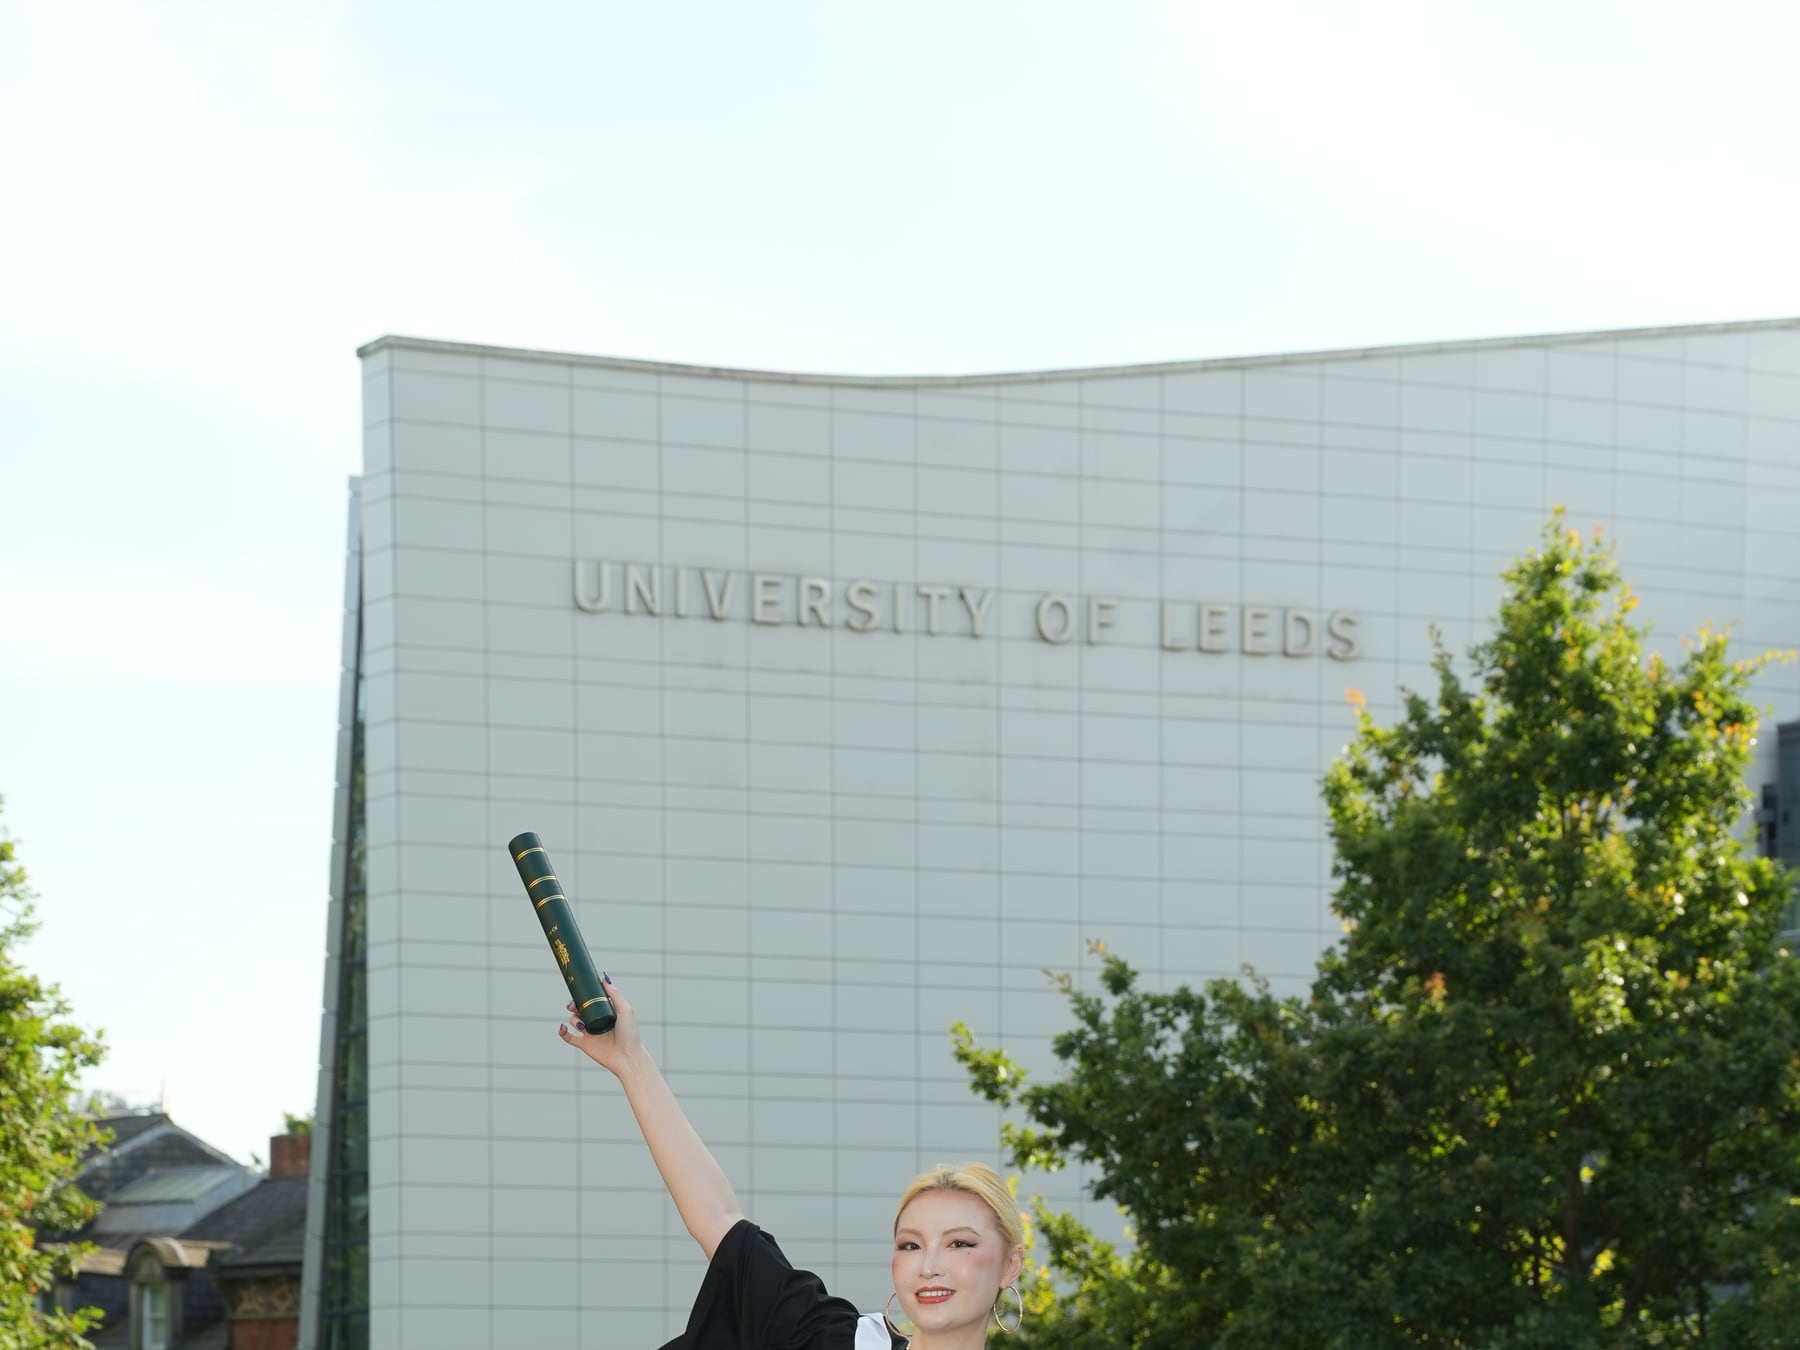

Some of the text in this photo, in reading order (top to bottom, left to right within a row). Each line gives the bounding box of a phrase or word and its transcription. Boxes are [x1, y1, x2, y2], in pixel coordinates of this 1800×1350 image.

[573, 559, 1361, 662] UNIVERSITY OF LEEDS
